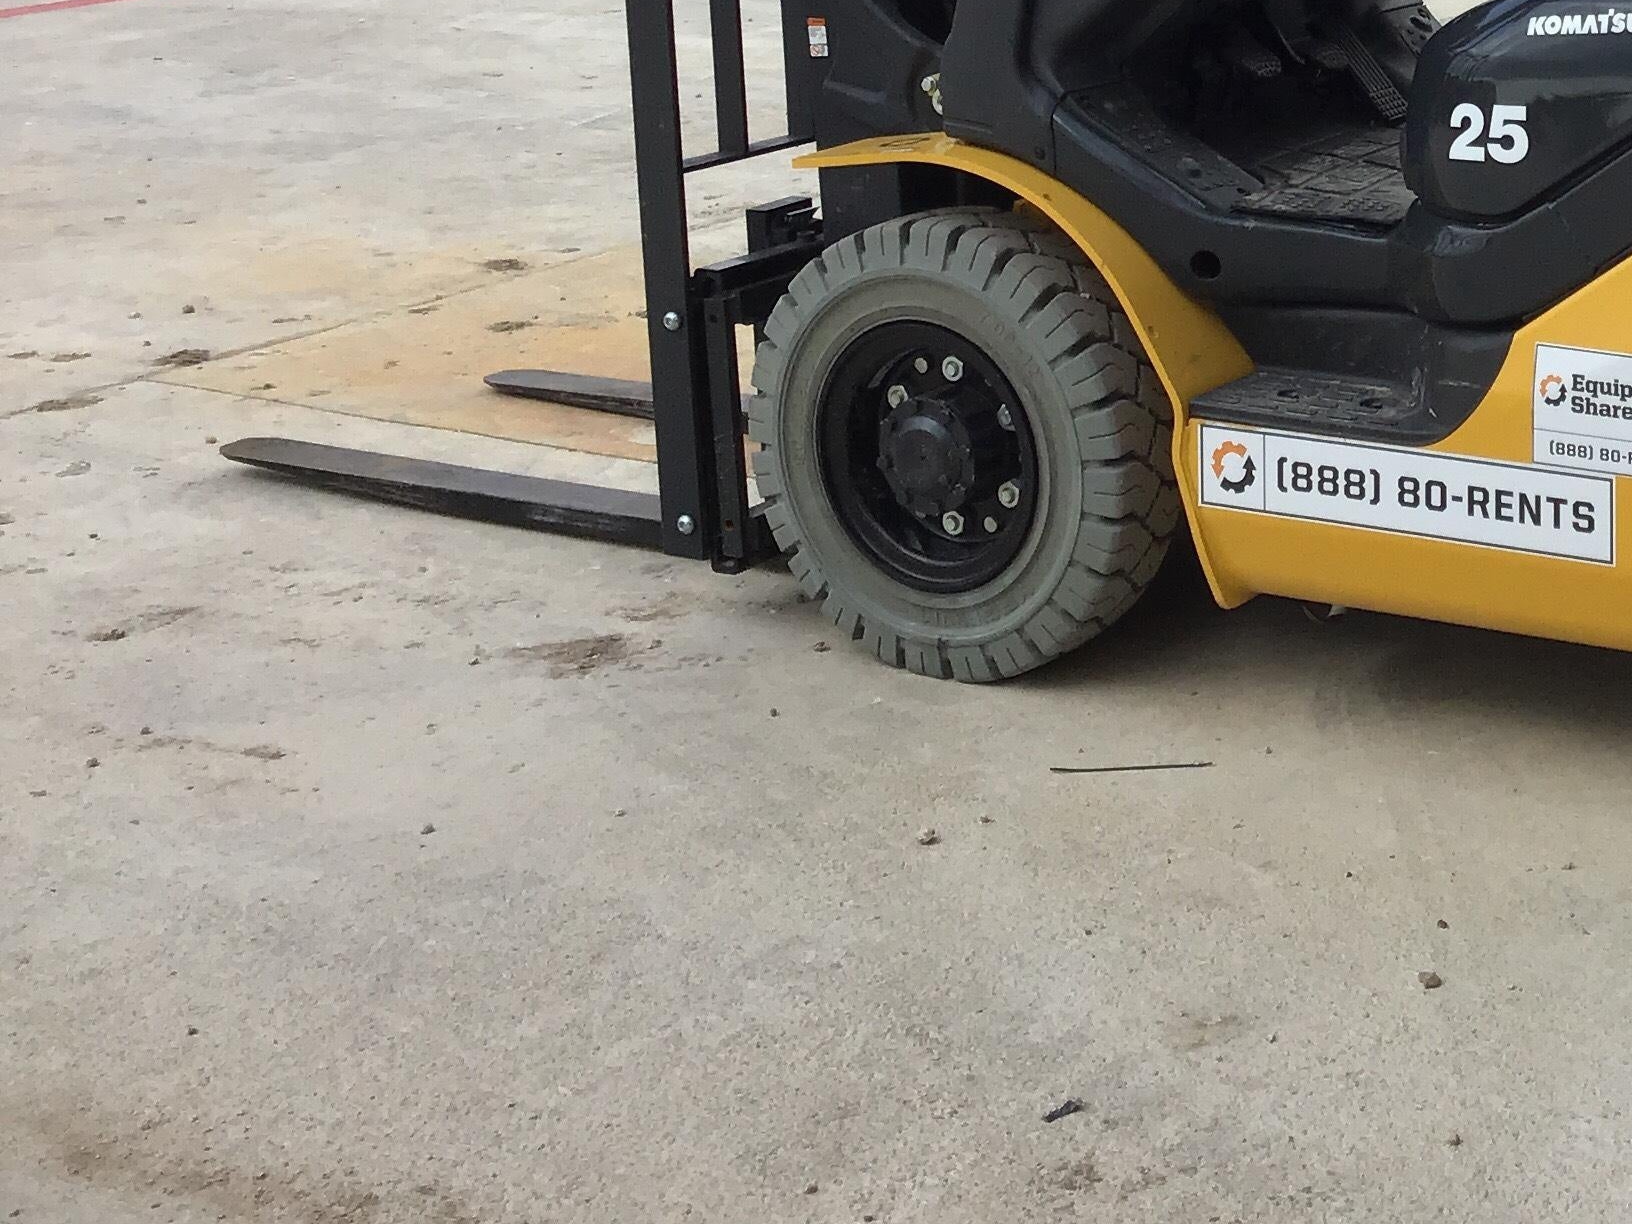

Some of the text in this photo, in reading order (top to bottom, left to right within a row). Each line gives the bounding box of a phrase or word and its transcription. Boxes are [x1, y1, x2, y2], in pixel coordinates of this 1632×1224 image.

[1448, 102, 1529, 164] 25
[1549, 439, 1594, 461] (888)
[1276, 456, 1596, 534] (888) 80-RENTS
